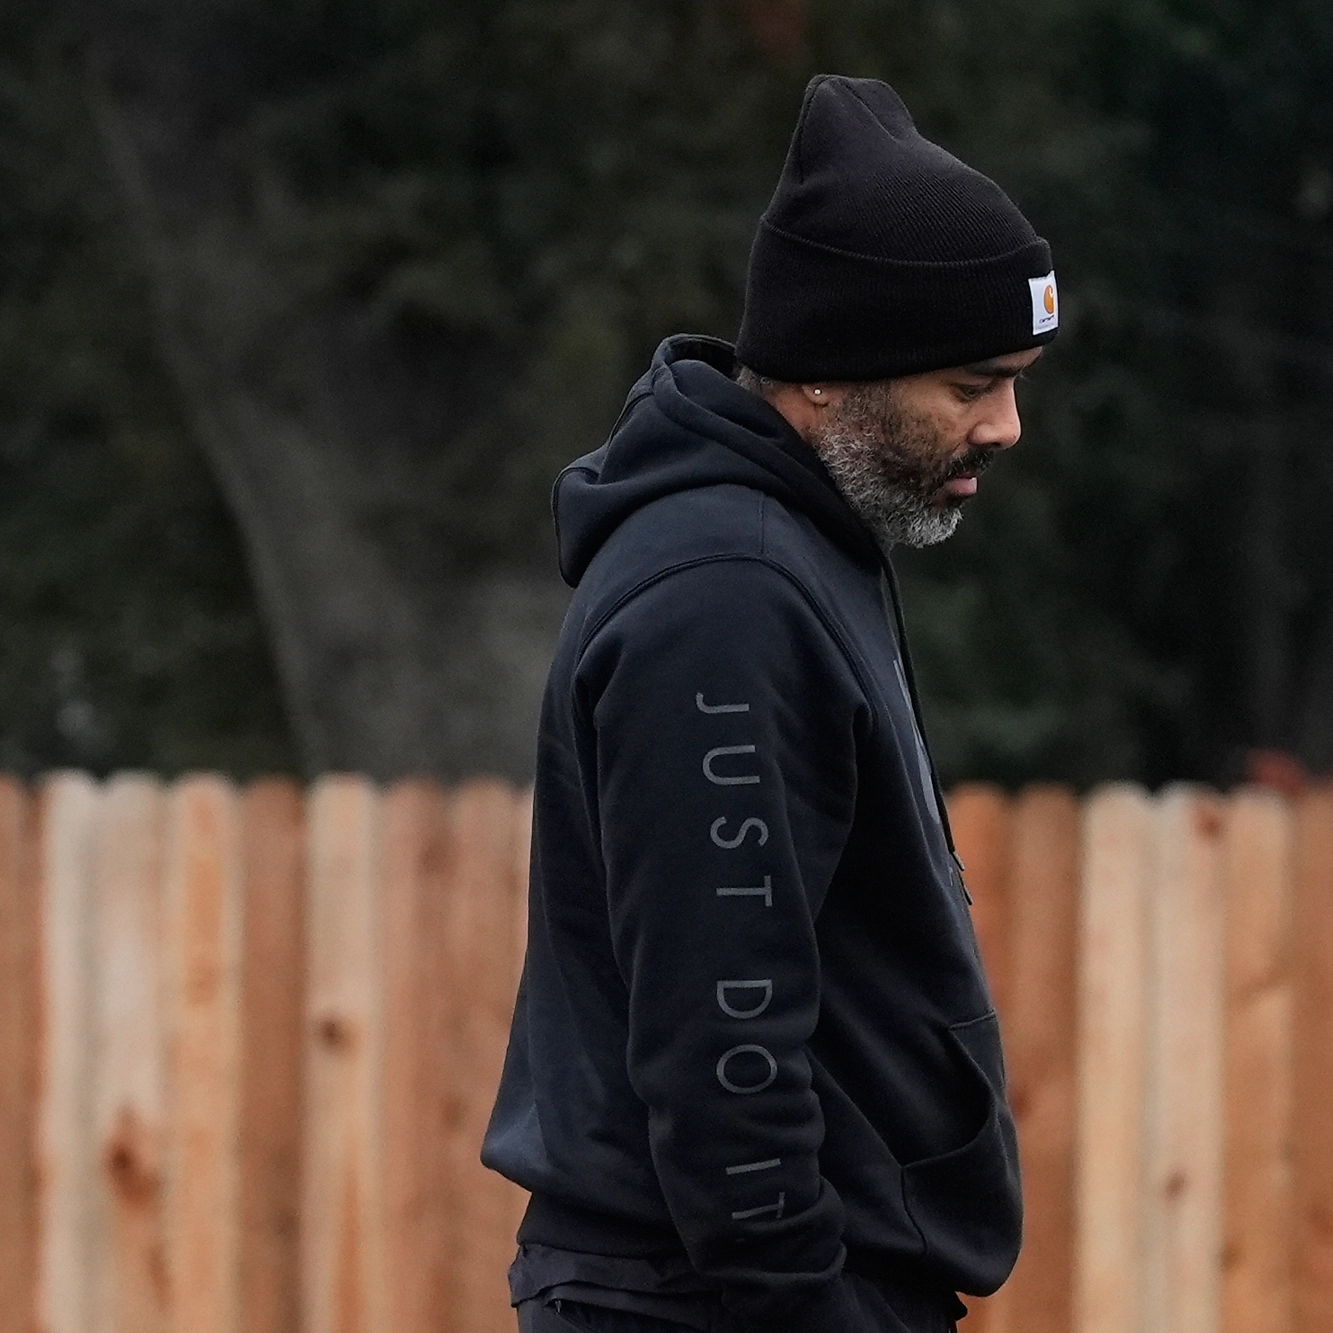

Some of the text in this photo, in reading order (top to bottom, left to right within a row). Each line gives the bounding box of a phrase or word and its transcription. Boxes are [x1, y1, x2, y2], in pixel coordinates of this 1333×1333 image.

[696, 692, 785, 1220] JUST DO IT
